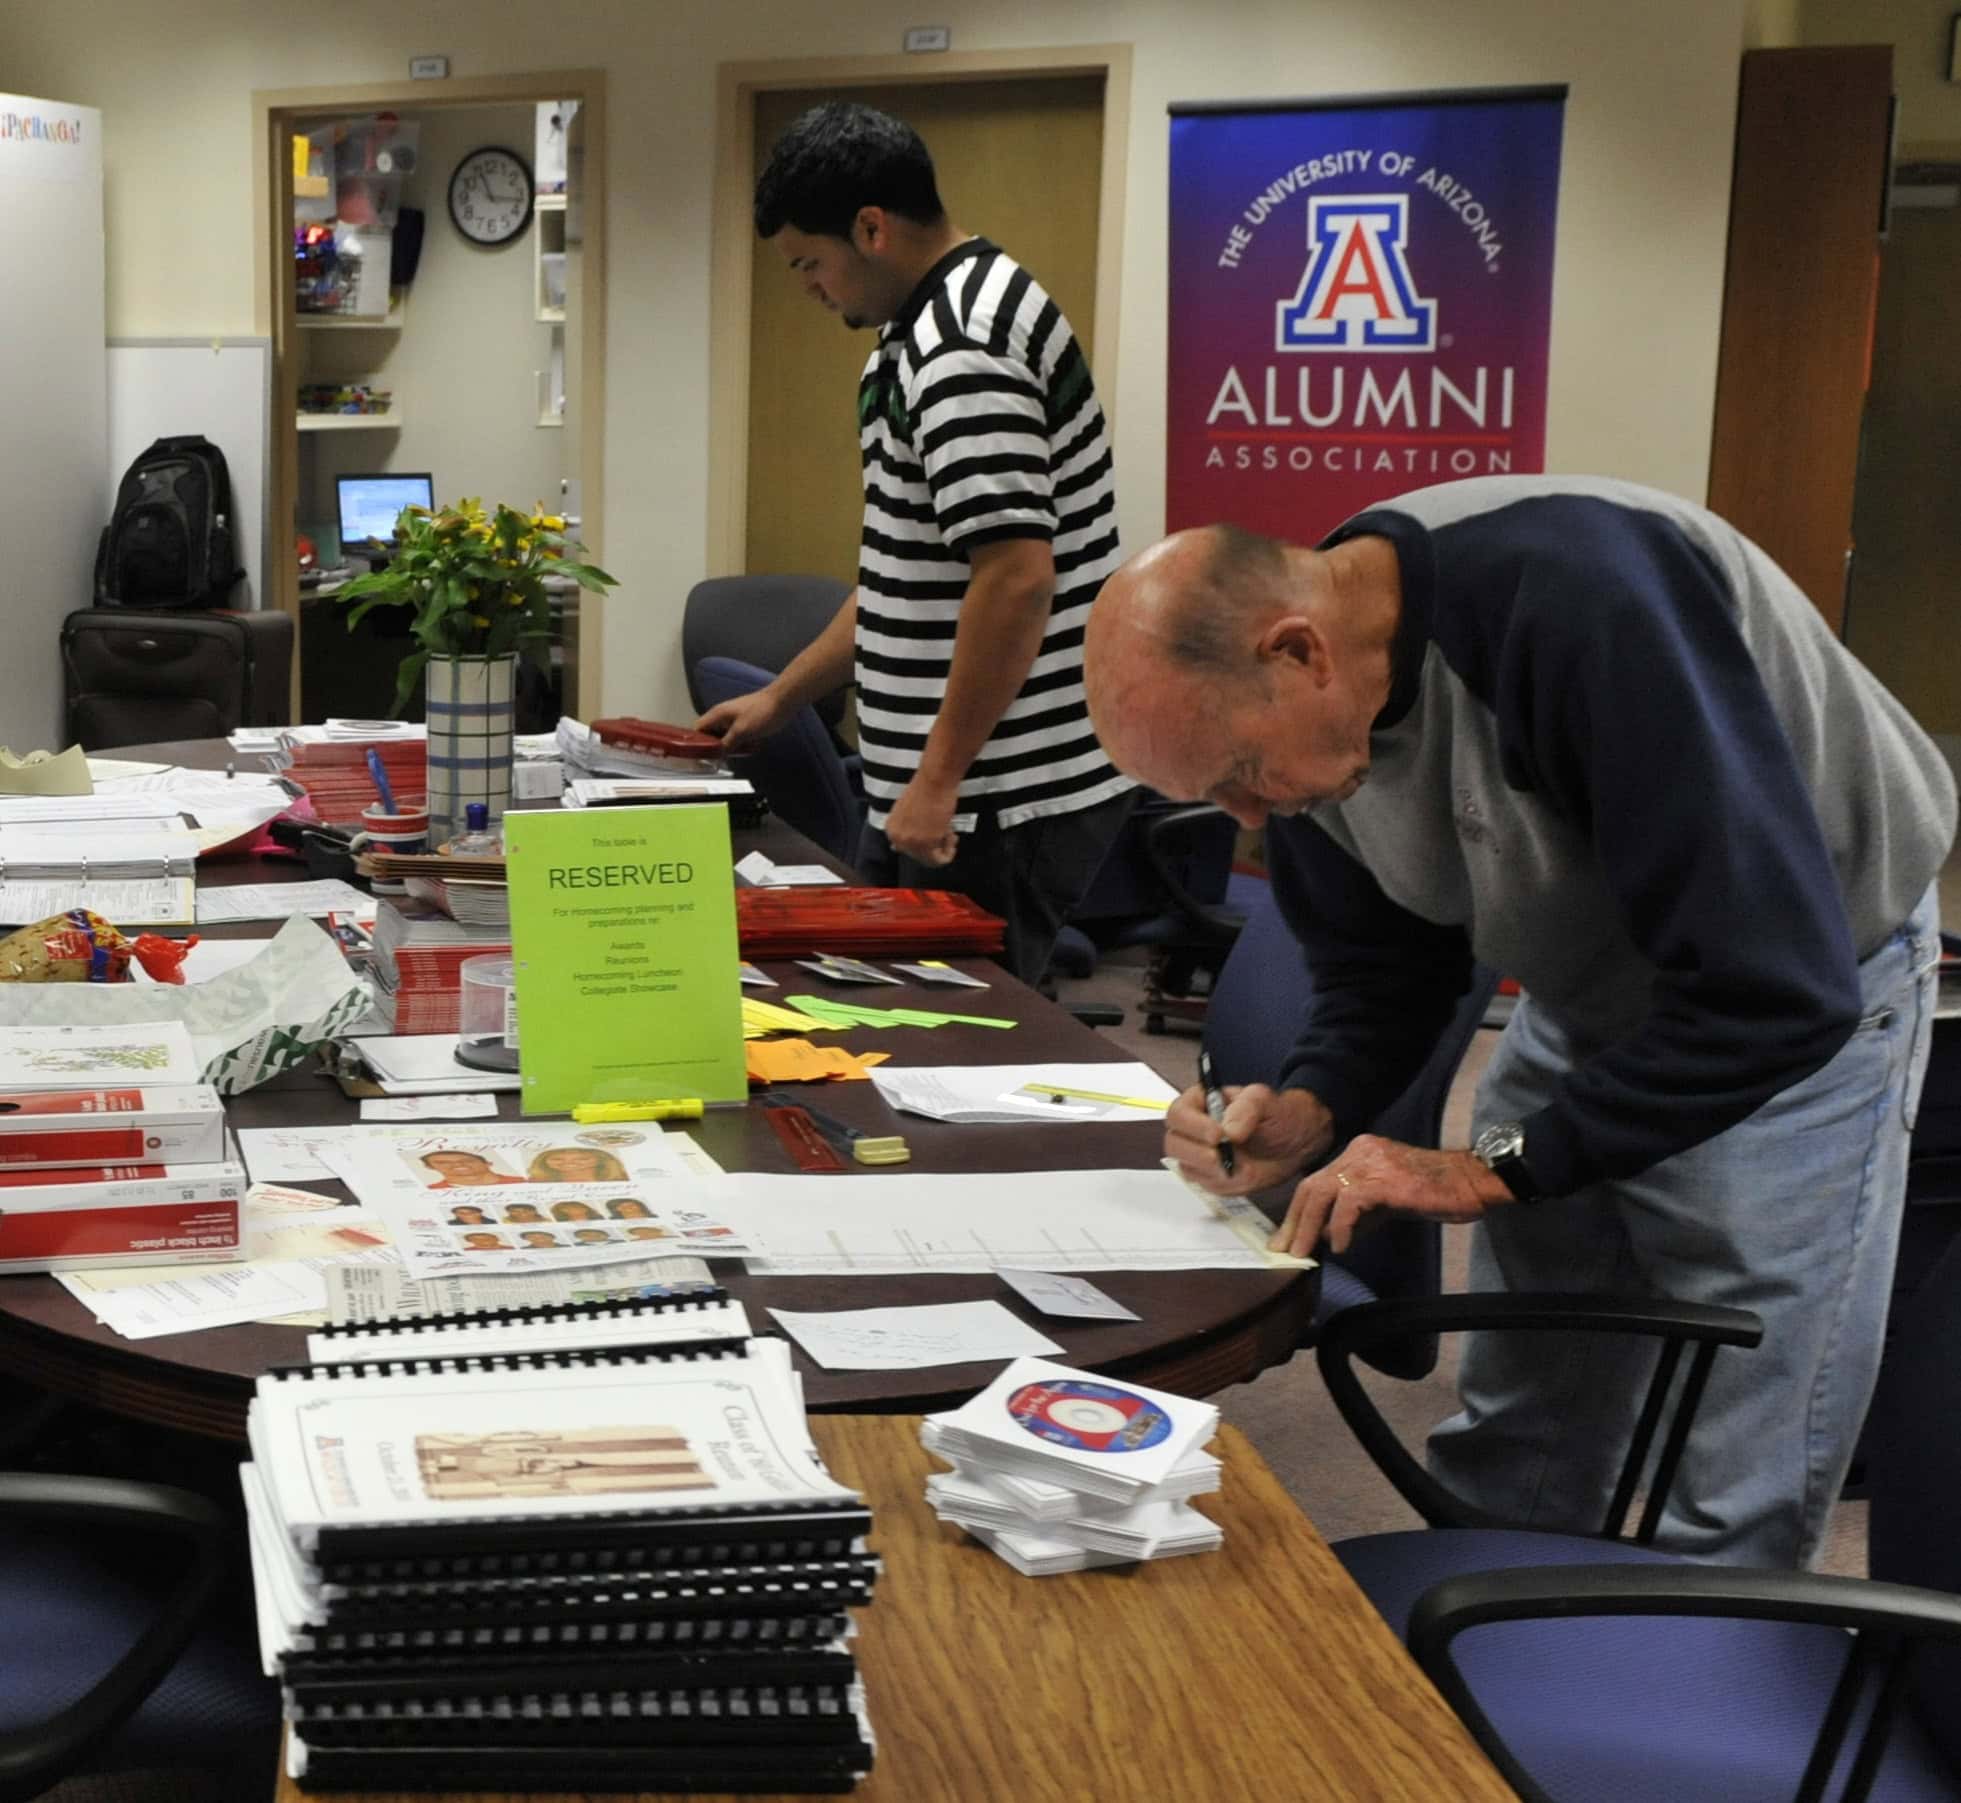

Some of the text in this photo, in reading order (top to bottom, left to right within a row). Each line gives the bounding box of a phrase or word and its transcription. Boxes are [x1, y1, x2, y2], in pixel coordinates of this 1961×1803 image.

[1218, 224, 1253, 269] THE
[1244, 150, 1373, 225] UNIVERSITY
[1379, 151, 1416, 177] OF
[1206, 366, 1514, 428] ALUMNI
[1205, 446, 1512, 473] ASSOCIATION
[549, 862, 693, 889] RESERVED
